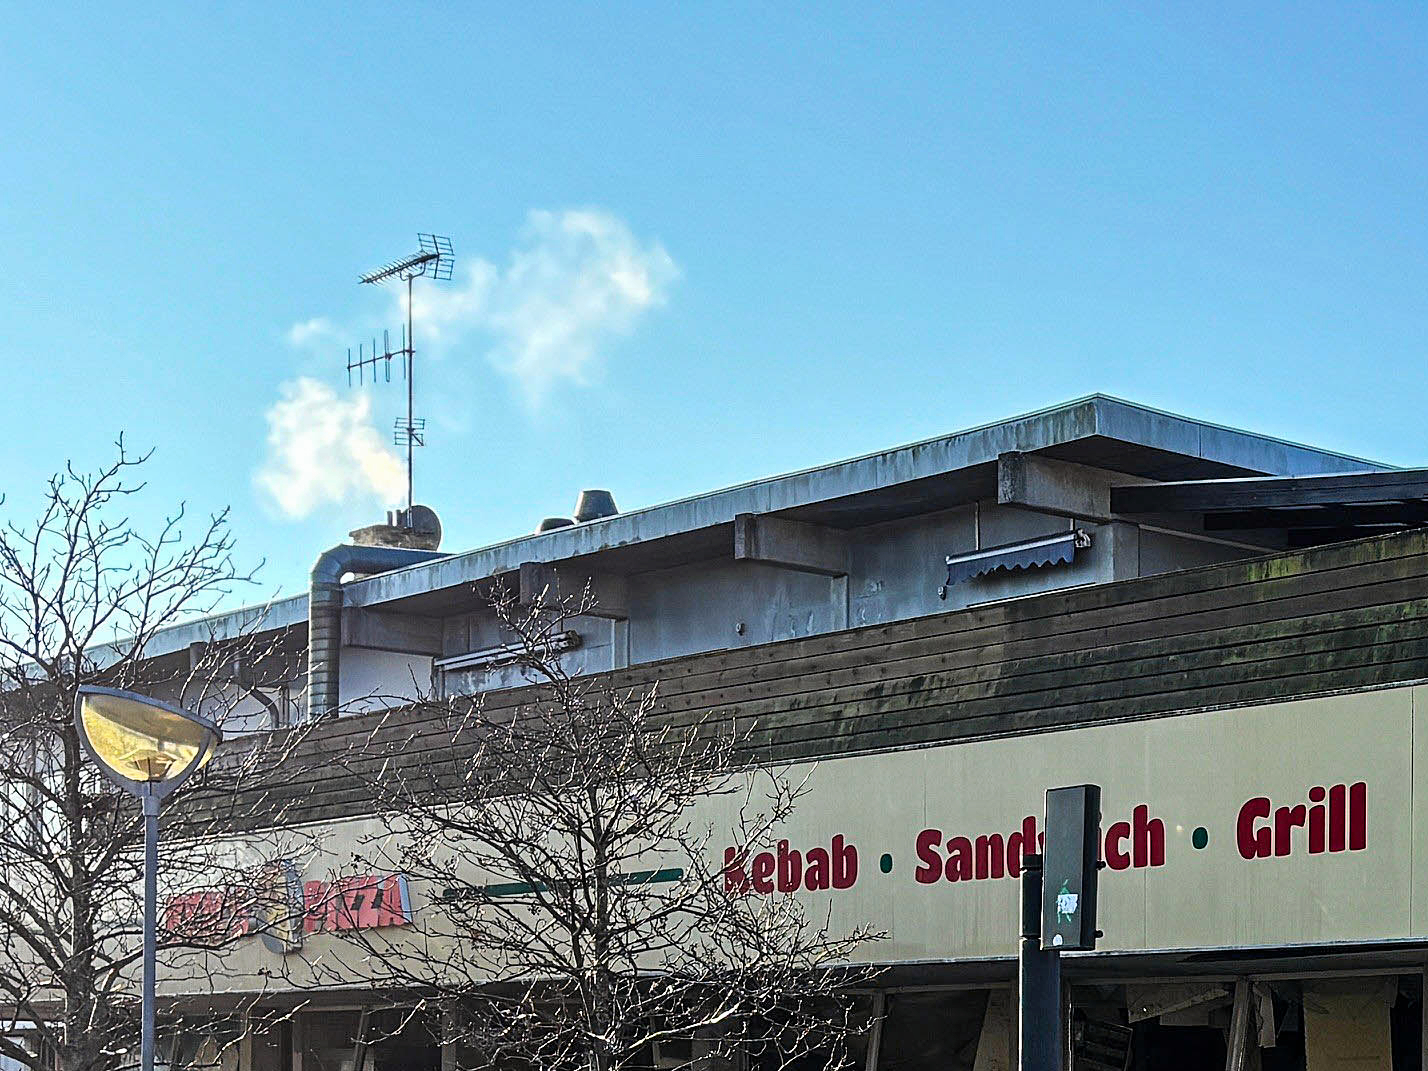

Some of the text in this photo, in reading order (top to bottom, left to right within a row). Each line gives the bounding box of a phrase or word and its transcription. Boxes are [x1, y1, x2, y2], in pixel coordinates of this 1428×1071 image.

[724, 781, 1368, 895] Kebab Sandch Grill
